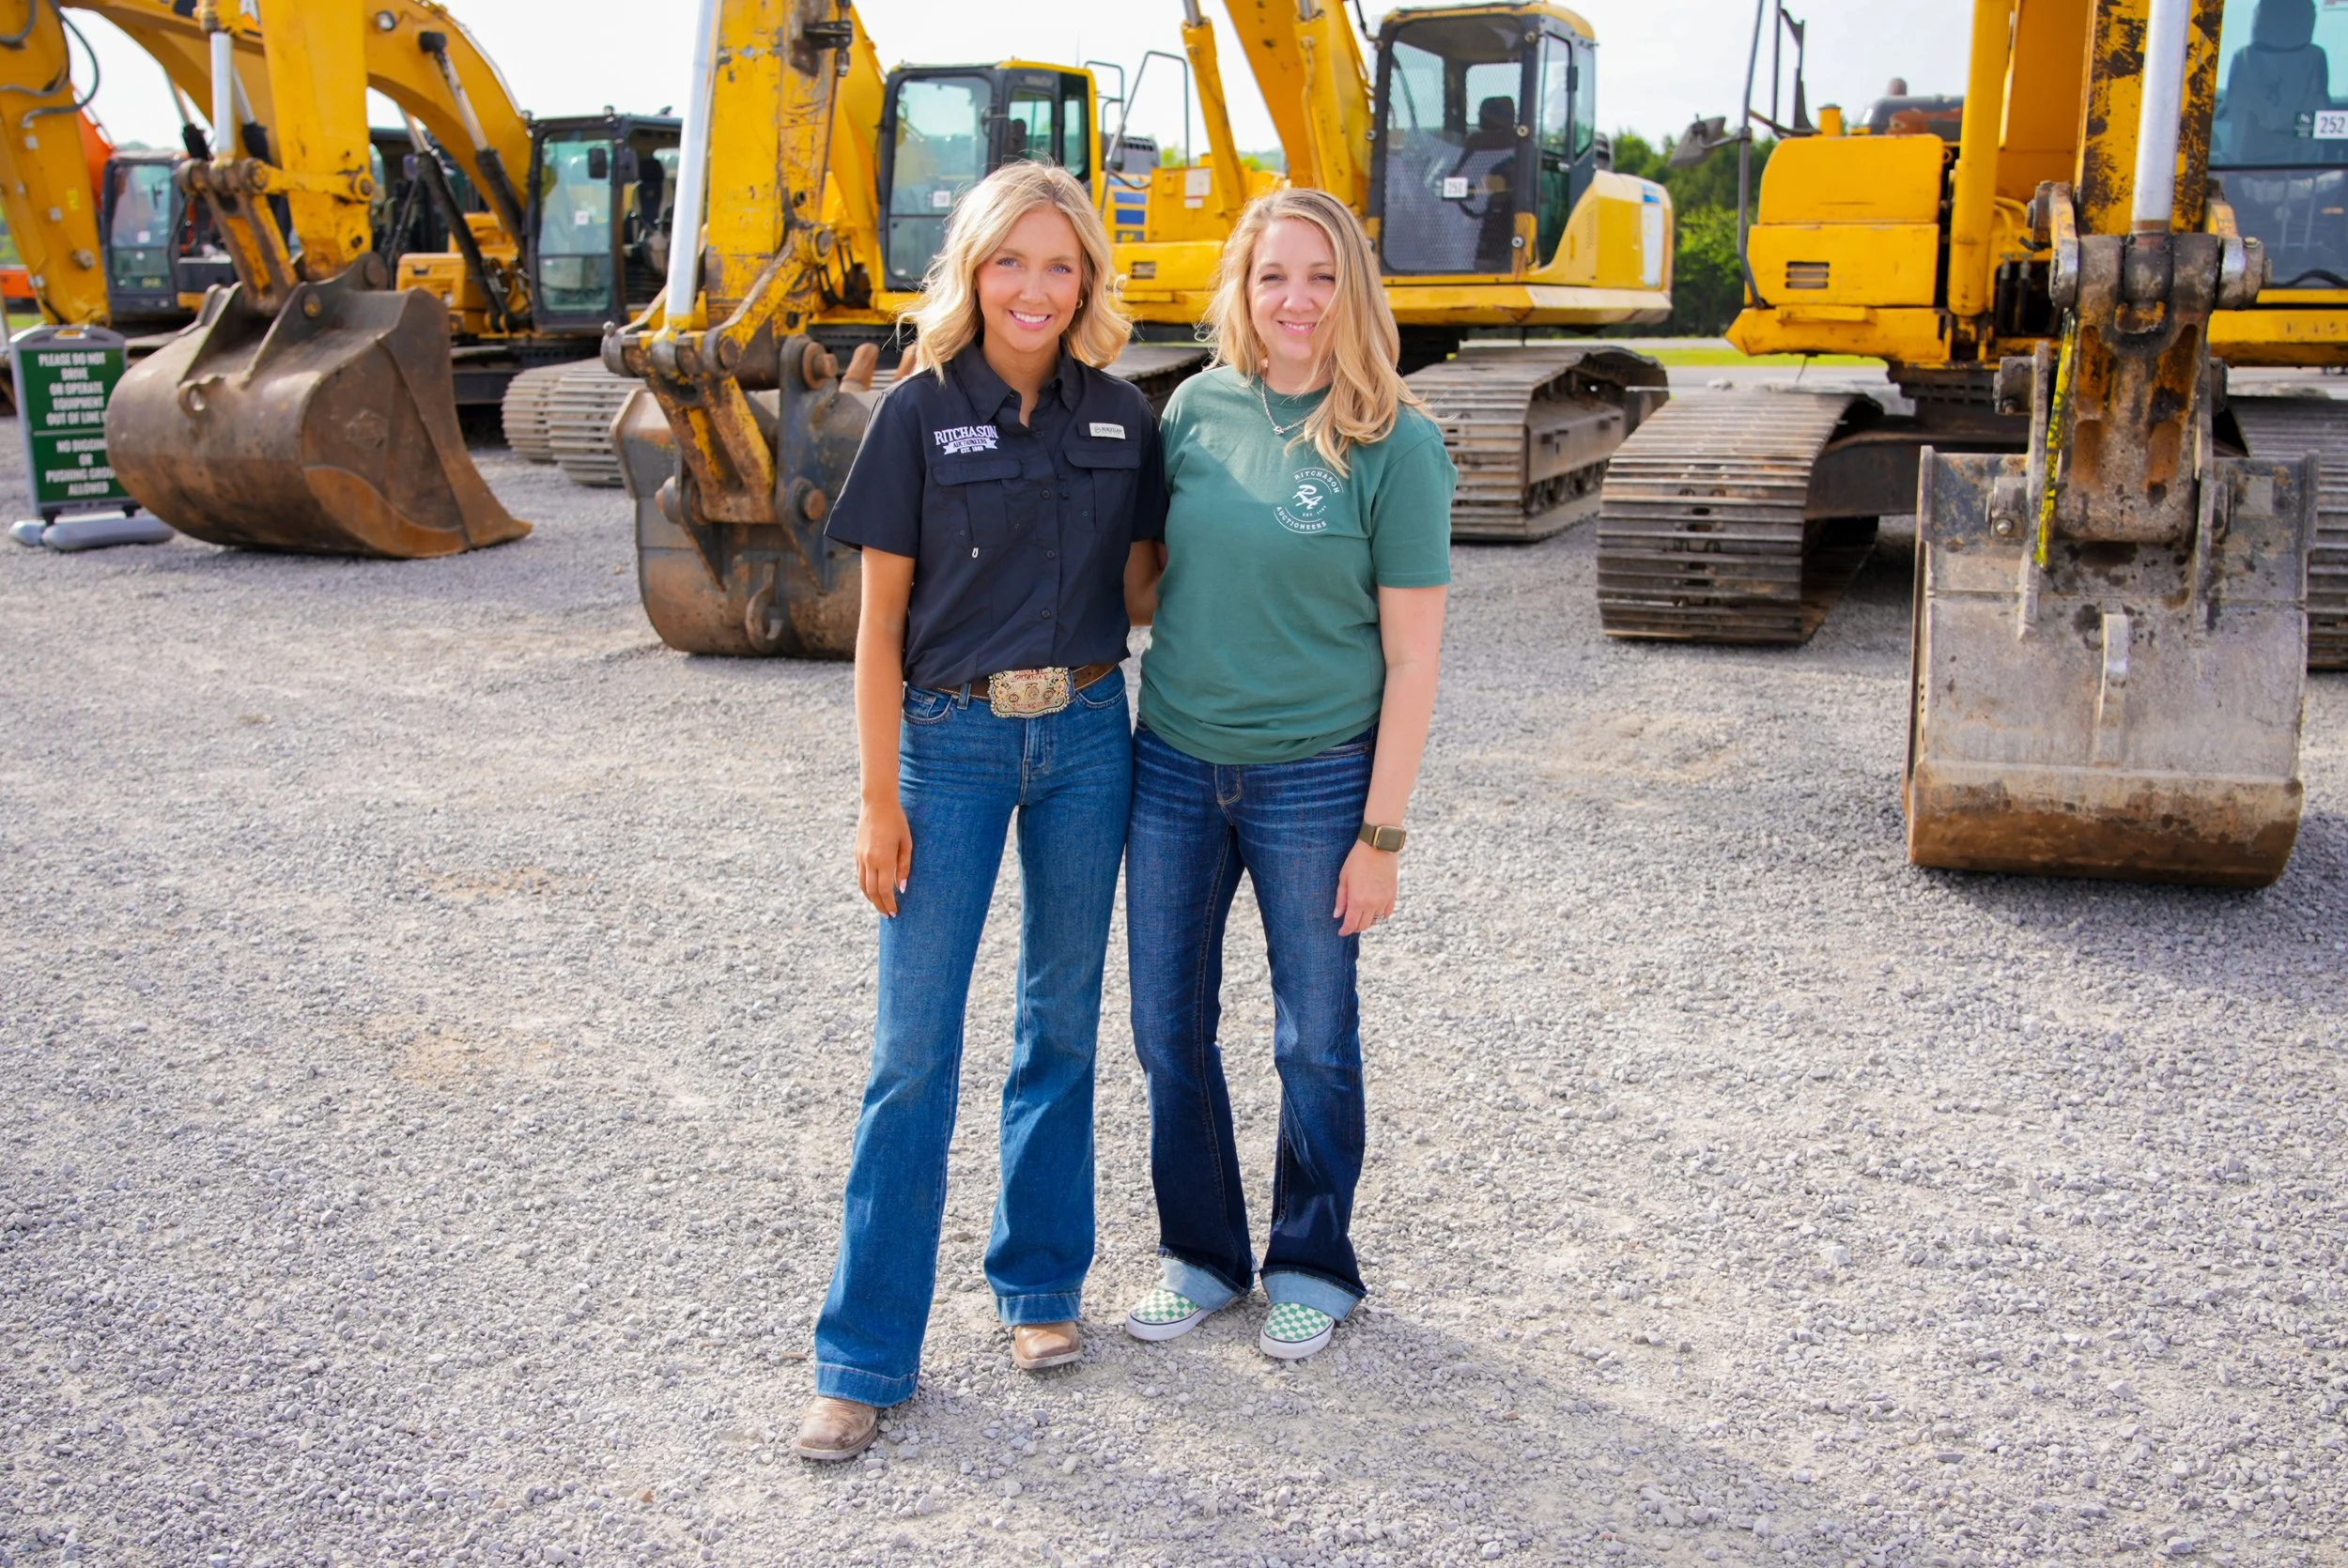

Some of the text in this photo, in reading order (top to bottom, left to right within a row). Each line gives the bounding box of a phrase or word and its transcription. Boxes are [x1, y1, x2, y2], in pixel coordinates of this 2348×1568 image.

[2320, 115, 2346, 133] 252
[38, 351, 105, 367] PLEASE DO NOT
[60, 367, 89, 381] DRIVE
[49, 381, 104, 396] OR OPERATE
[53, 395, 104, 410] EQUIPMENT
[46, 412, 67, 426] OUT
[67, 411, 80, 425] OF
[81, 410, 100, 424] LINE
[934, 425, 998, 445] RITCHASON
[56, 438, 108, 453] NO DIGGIN
[953, 438, 987, 448] AUCTIONEERS
[79, 453, 94, 467] OR
[45, 468, 88, 484] PUSHING
[1294, 470, 1340, 493] RITCHASON
[68, 481, 110, 496] ALLOWED
[1276, 506, 1327, 530] AUCTIONEERS
